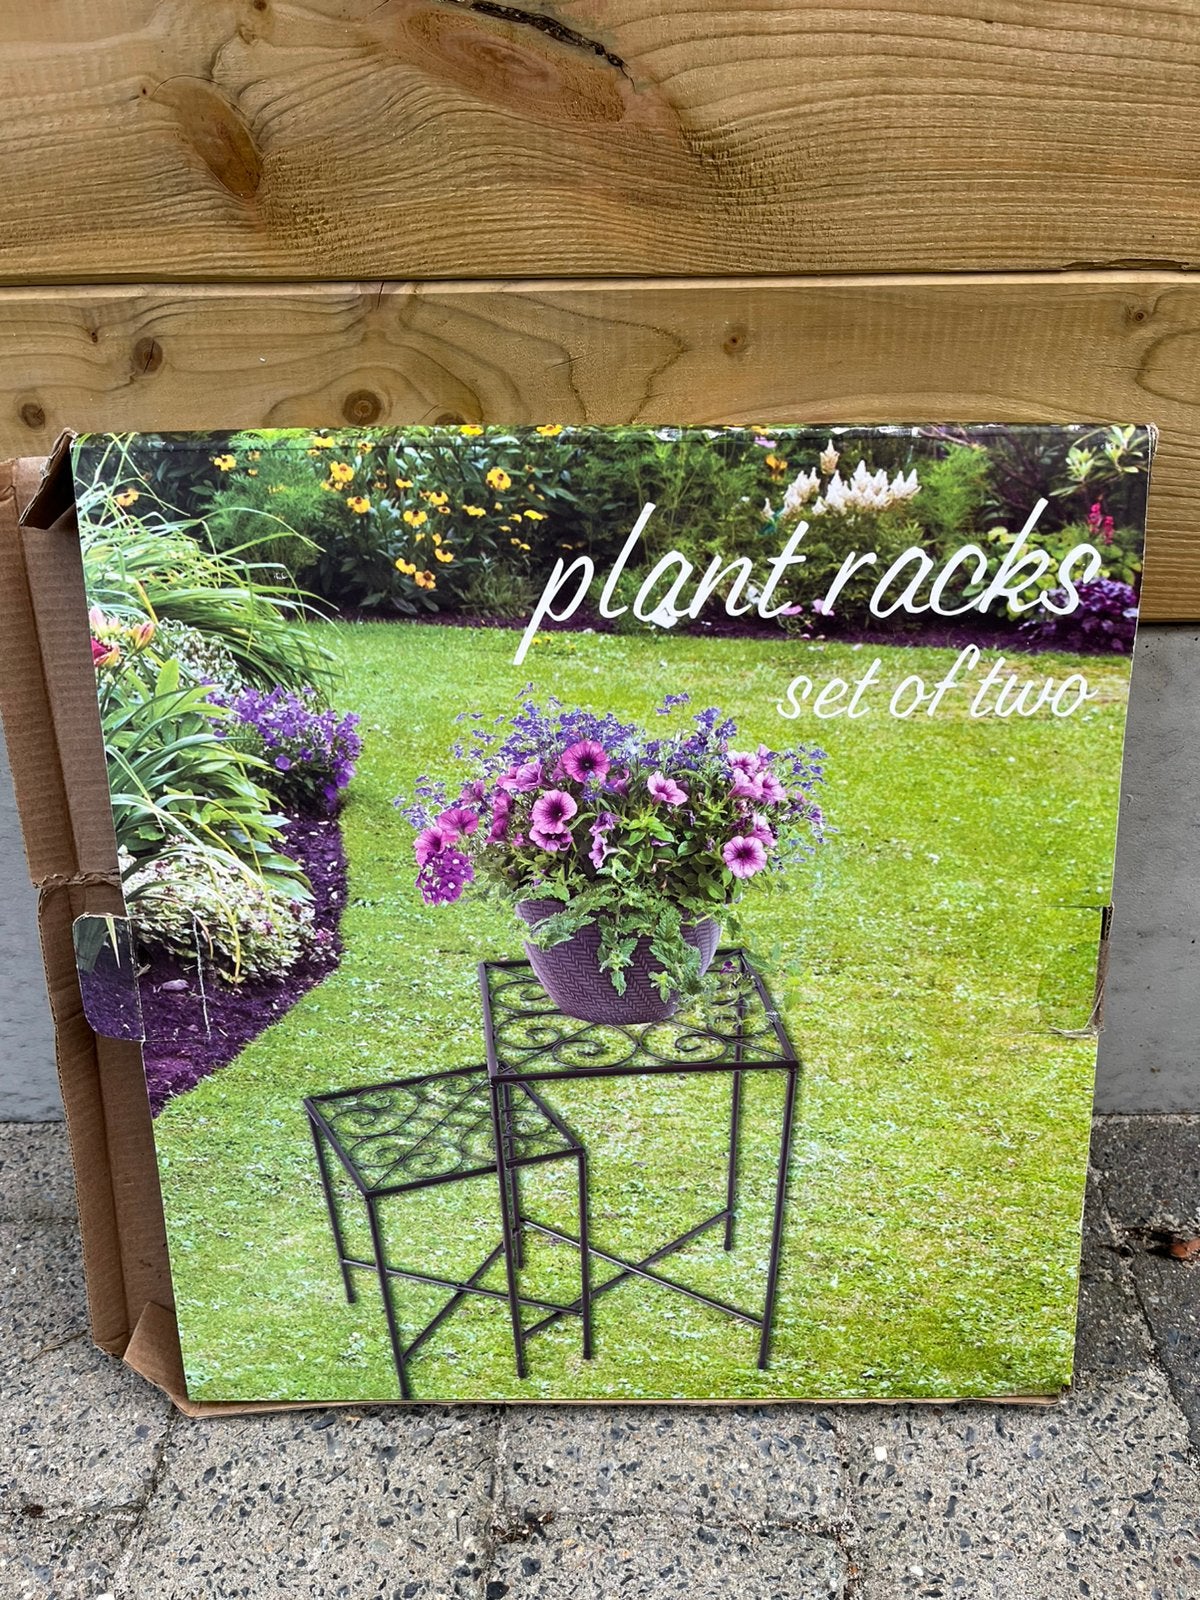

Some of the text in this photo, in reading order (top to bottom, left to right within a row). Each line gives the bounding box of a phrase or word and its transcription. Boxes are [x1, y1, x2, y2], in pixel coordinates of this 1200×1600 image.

[513, 498, 1102, 665] plant racks
[776, 643, 1098, 719] set of two
